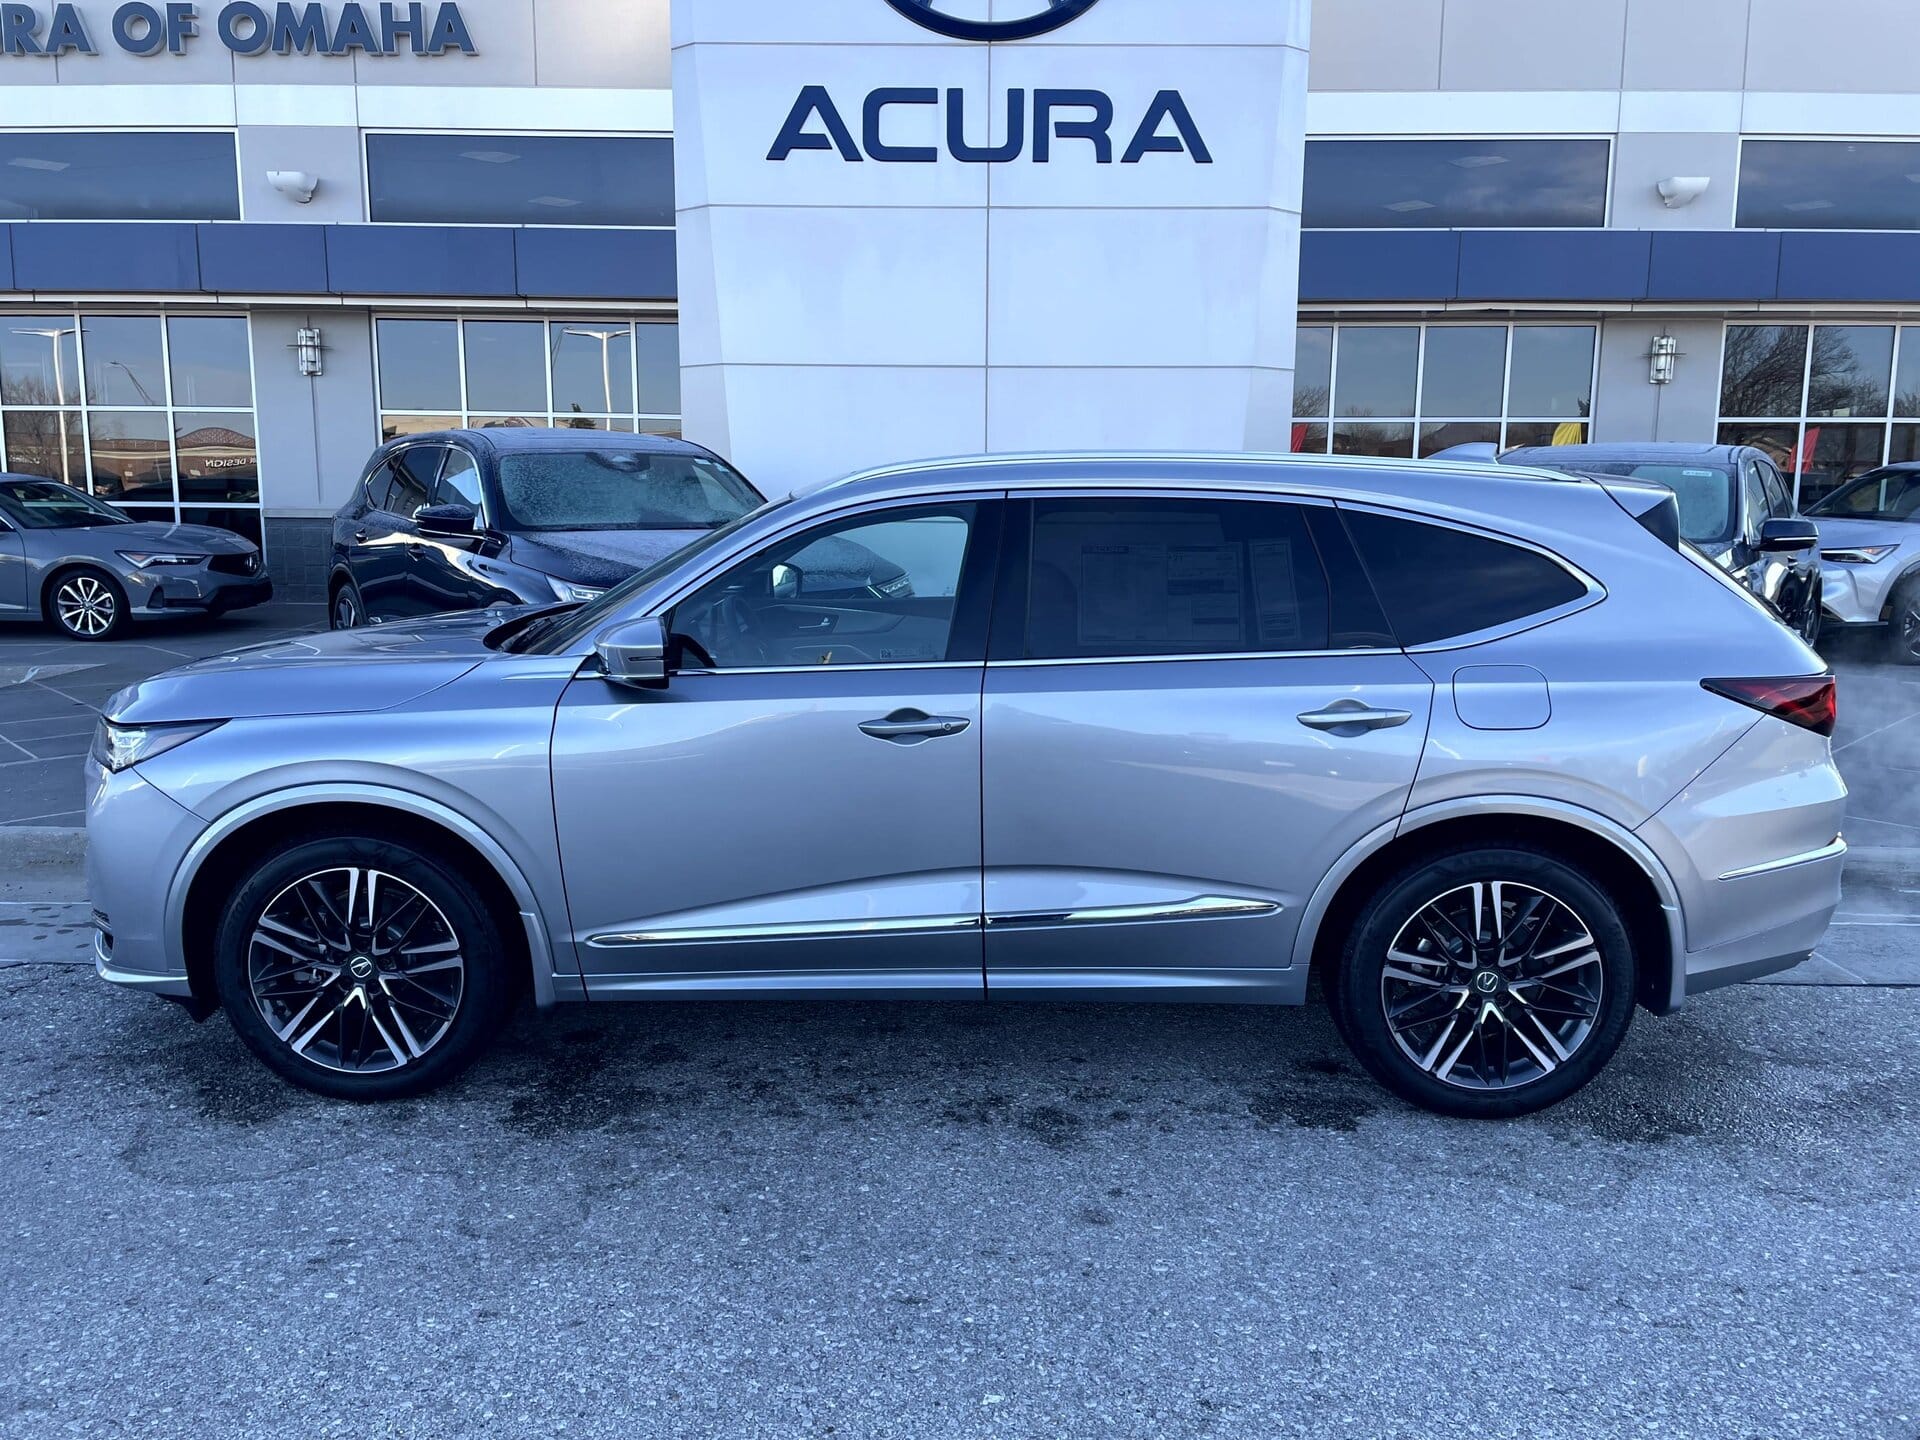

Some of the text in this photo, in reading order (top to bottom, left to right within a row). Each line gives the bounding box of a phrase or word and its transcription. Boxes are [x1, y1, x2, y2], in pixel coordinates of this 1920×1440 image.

[112, 1, 199, 56] OF
[217, 1, 479, 57] OMAHA
[766, 85, 1213, 163] ACURA
